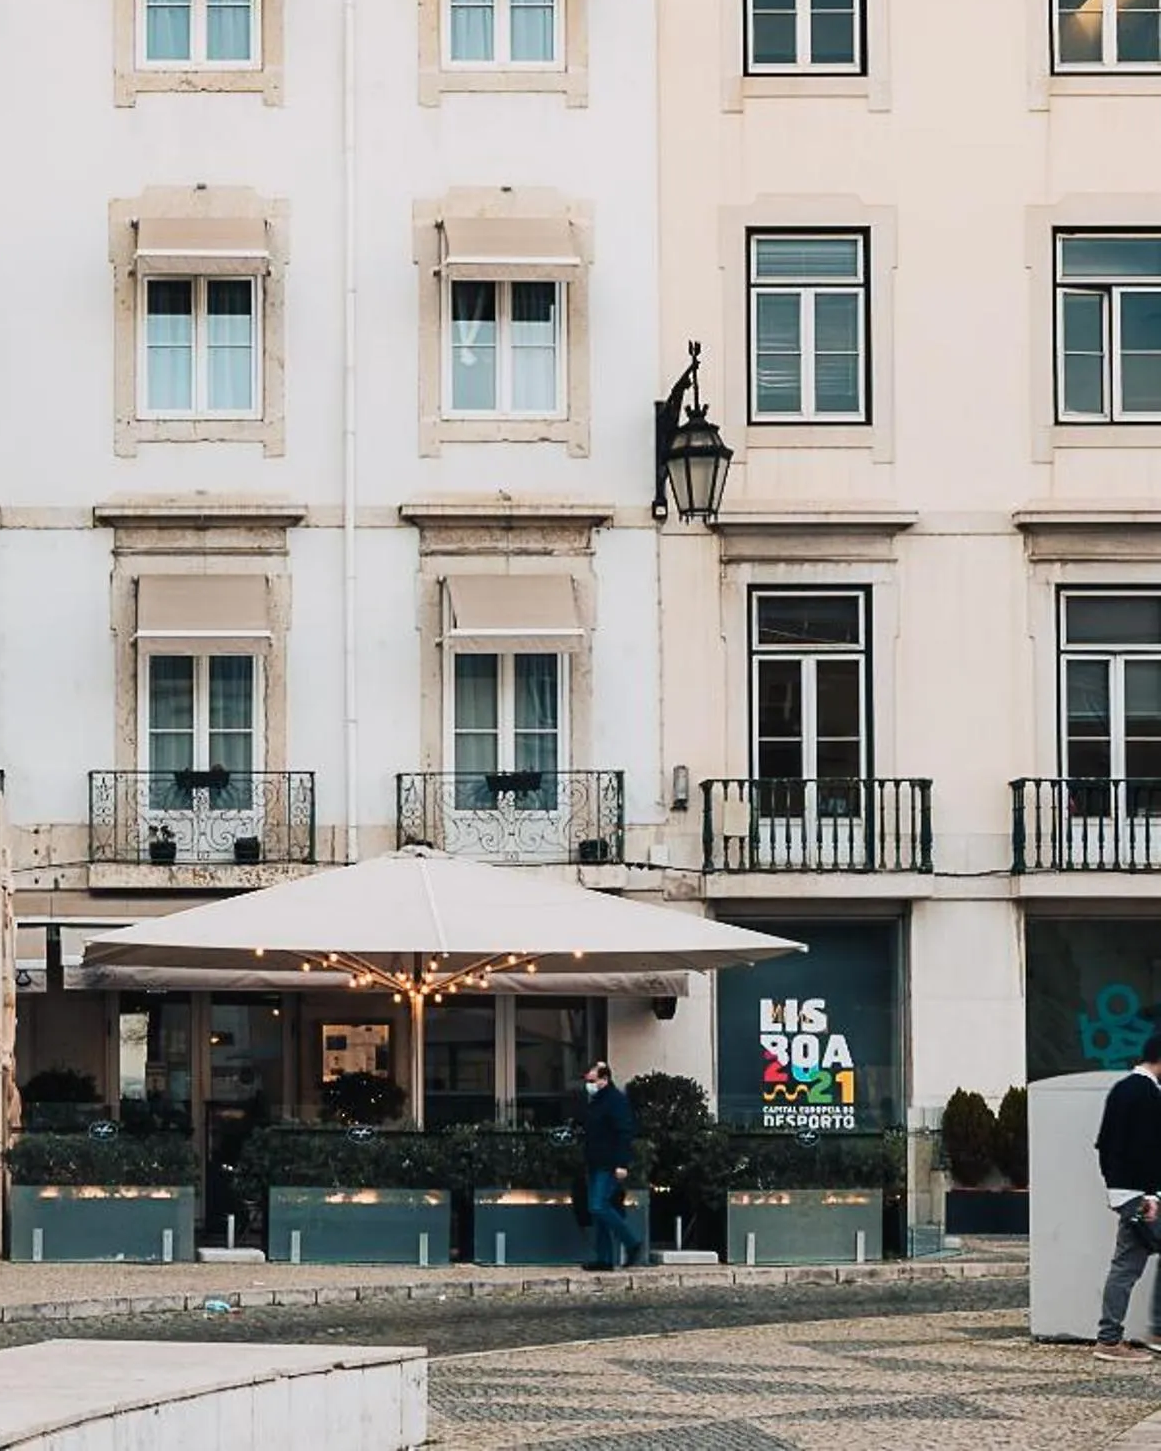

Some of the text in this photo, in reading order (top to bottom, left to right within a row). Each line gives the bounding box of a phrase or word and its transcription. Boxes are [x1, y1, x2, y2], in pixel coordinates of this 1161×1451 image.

[759, 998, 827, 1032] LIS
[762, 1105, 798, 1114] CAPITAL
[763, 1114, 855, 1129] DESPORTO
